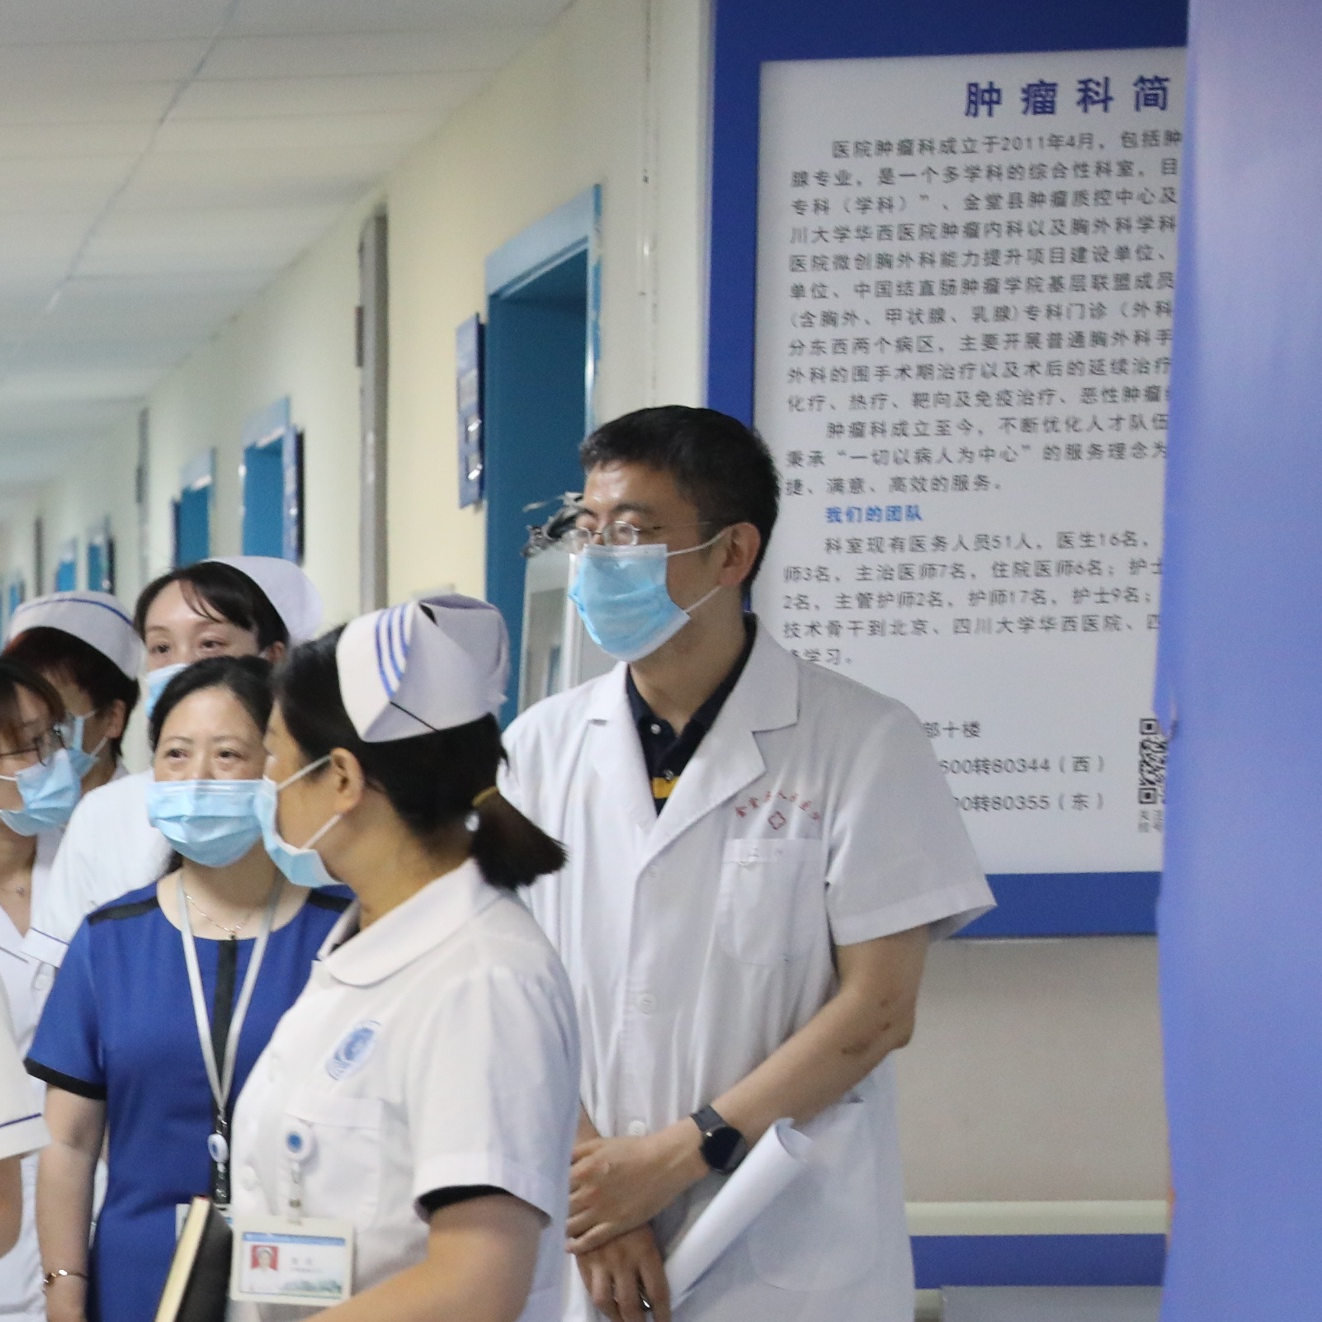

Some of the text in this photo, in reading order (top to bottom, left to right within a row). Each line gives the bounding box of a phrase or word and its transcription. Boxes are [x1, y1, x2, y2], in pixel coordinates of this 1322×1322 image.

[963, 74, 1171, 119] 肿瘤科简
[787, 384, 1170, 413] 化疗、热疗、靶向及免疫治疗、恶性肿瘤
[824, 504, 924, 525] 我们的团队
